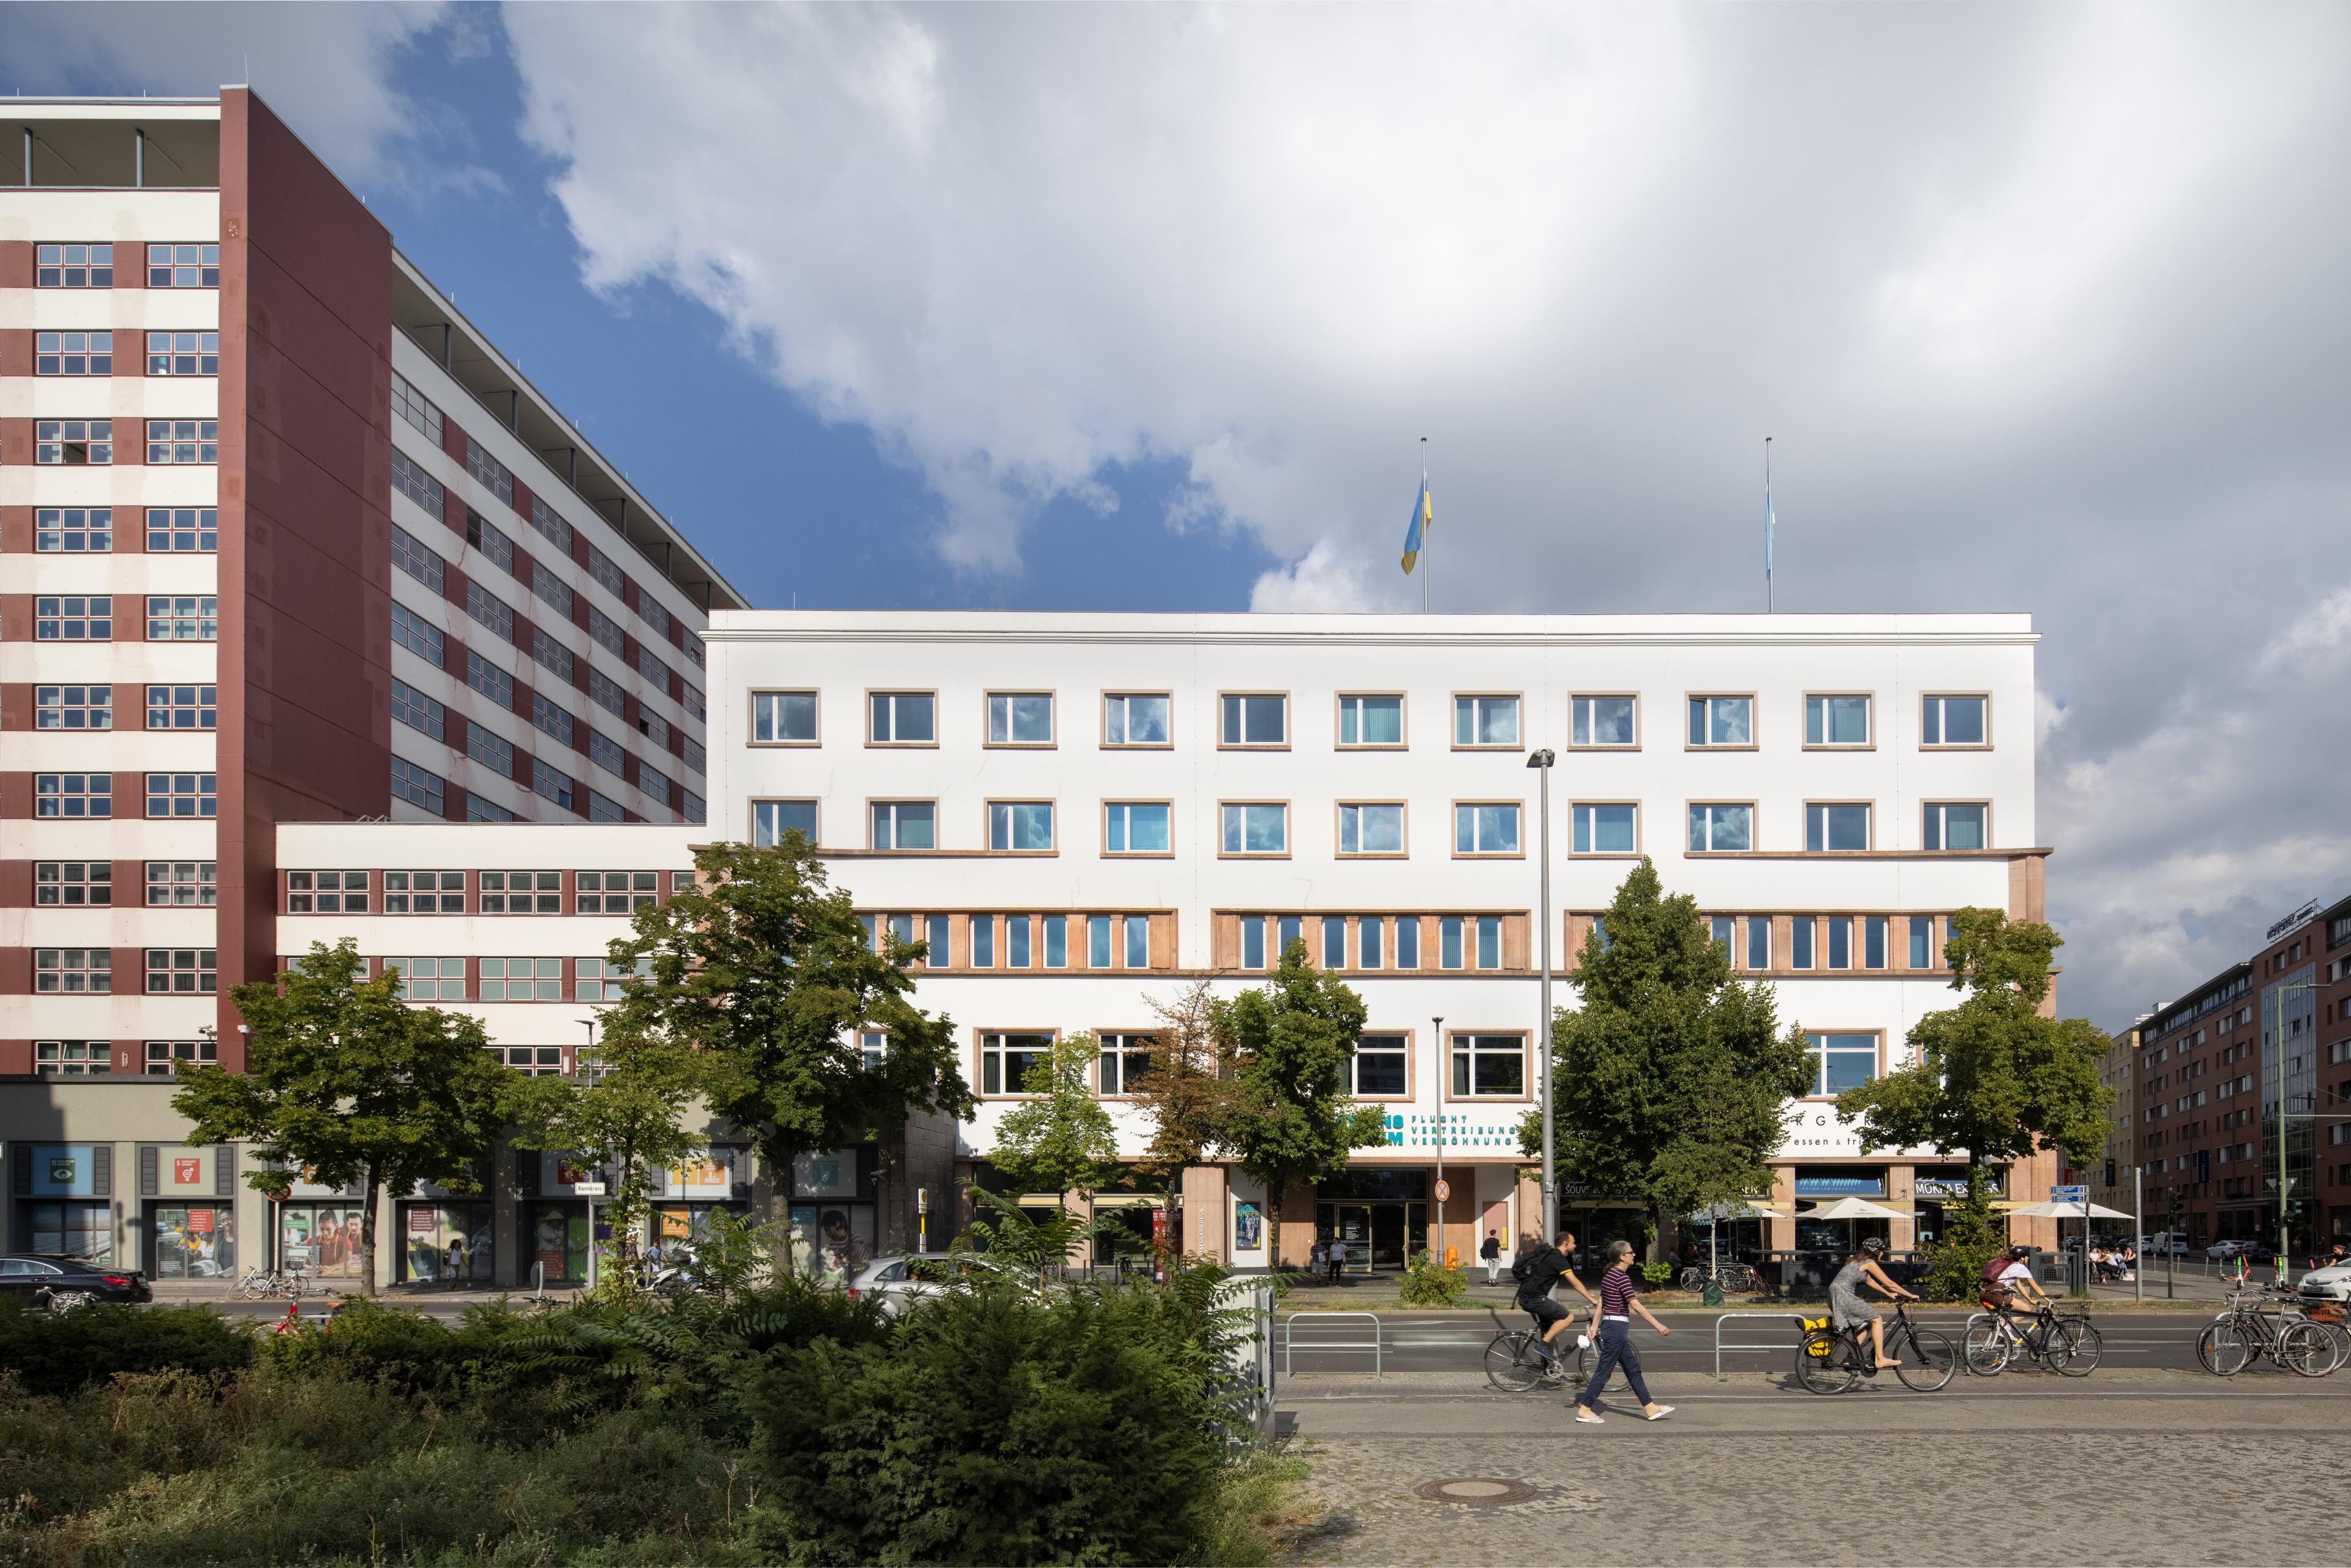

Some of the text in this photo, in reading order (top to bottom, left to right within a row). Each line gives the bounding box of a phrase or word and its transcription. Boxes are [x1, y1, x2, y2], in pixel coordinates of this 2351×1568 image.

[1411, 1115, 1467, 1123] FLUCHT
[1411, 1126, 1516, 1135] VERTREIBUNG
[1411, 1136, 1512, 1146] VERSÖHNUNG
